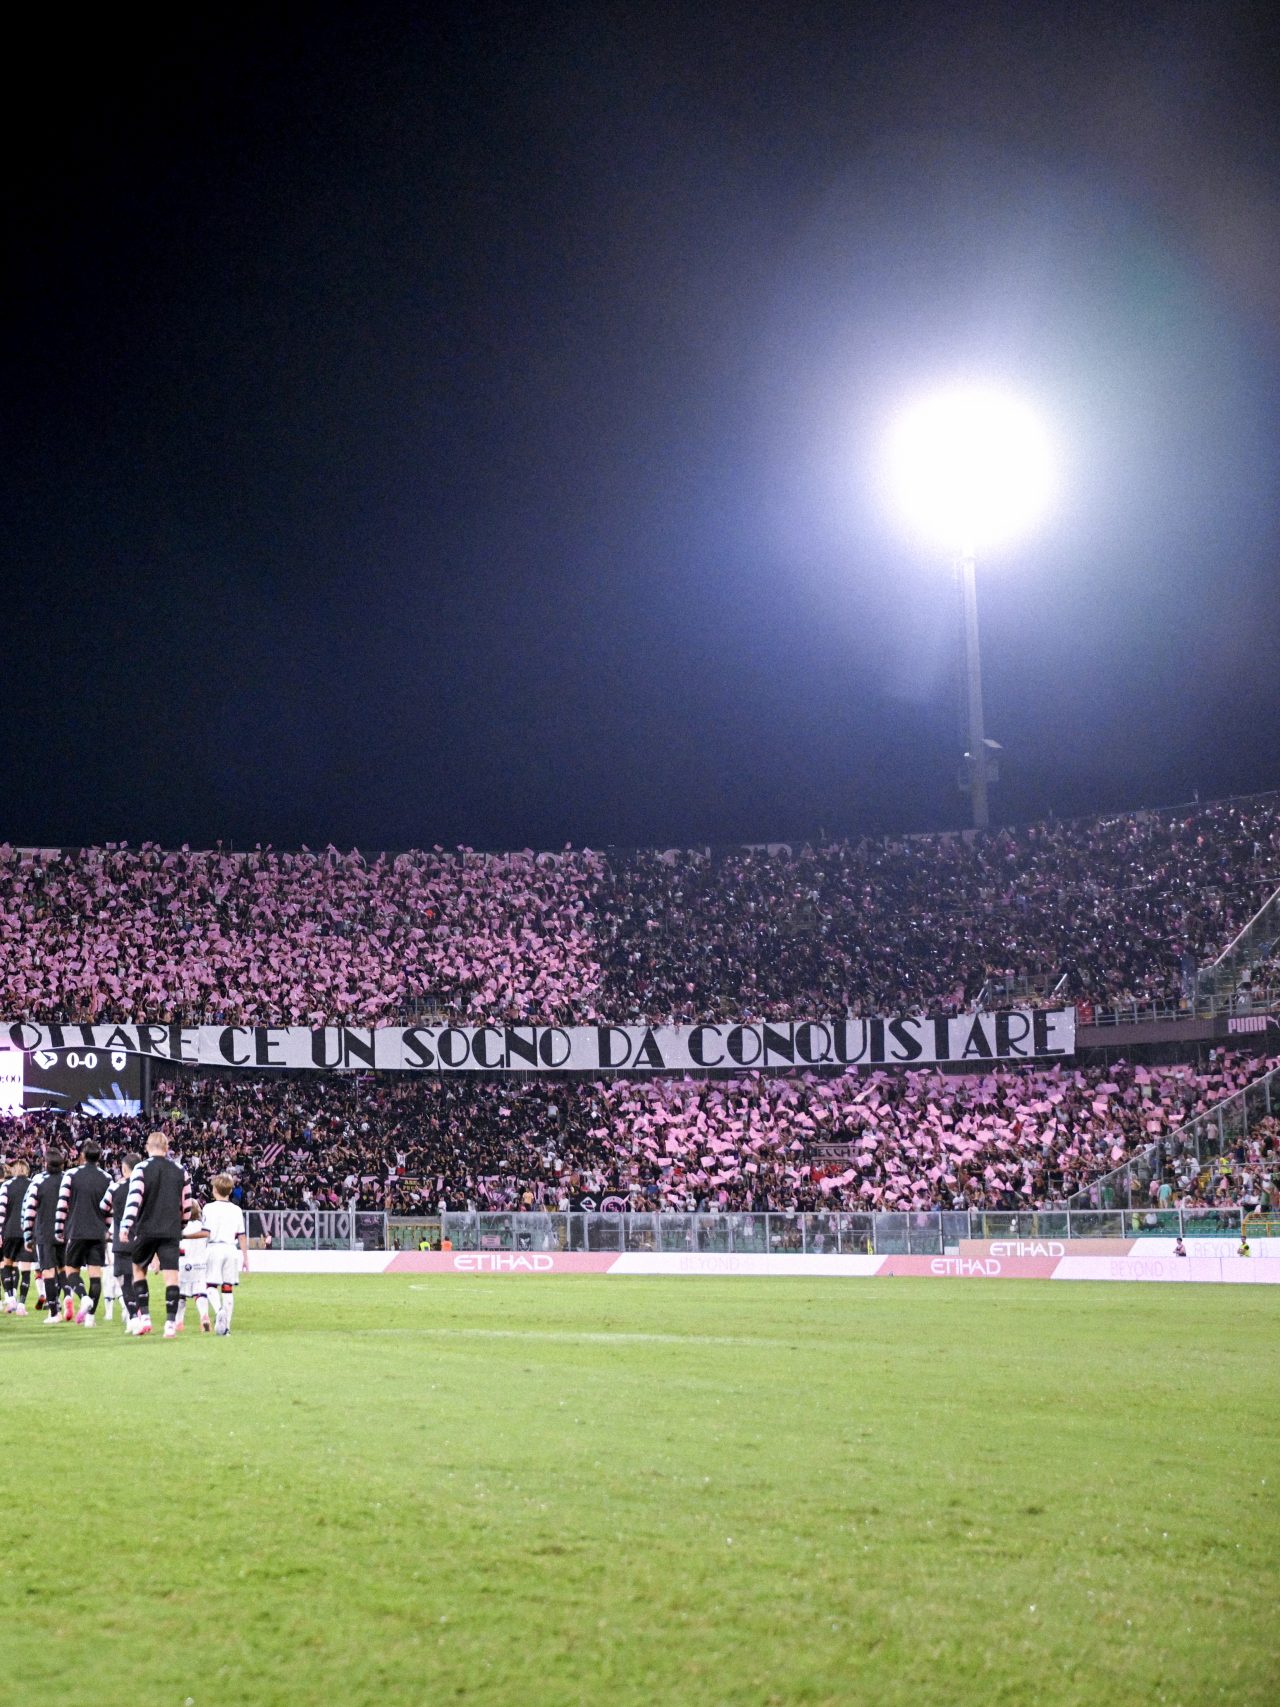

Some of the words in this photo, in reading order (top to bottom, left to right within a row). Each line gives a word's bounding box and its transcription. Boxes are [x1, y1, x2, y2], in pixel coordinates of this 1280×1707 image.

[1227, 1016, 1267, 1034] PUMA
[311, 1026, 376, 1068] UN
[402, 1027, 572, 1068] SOGNO
[597, 1027, 666, 1068] DA
[687, 1008, 1066, 1066] CONQUISTARE
[66, 1052, 98, 1069] 0-0
[259, 1212, 350, 1239] VECCHIO
[989, 1242, 1065, 1257] ETIHAD
[453, 1254, 554, 1271] ETIHAD
[930, 1258, 1002, 1275] ETIHAD
